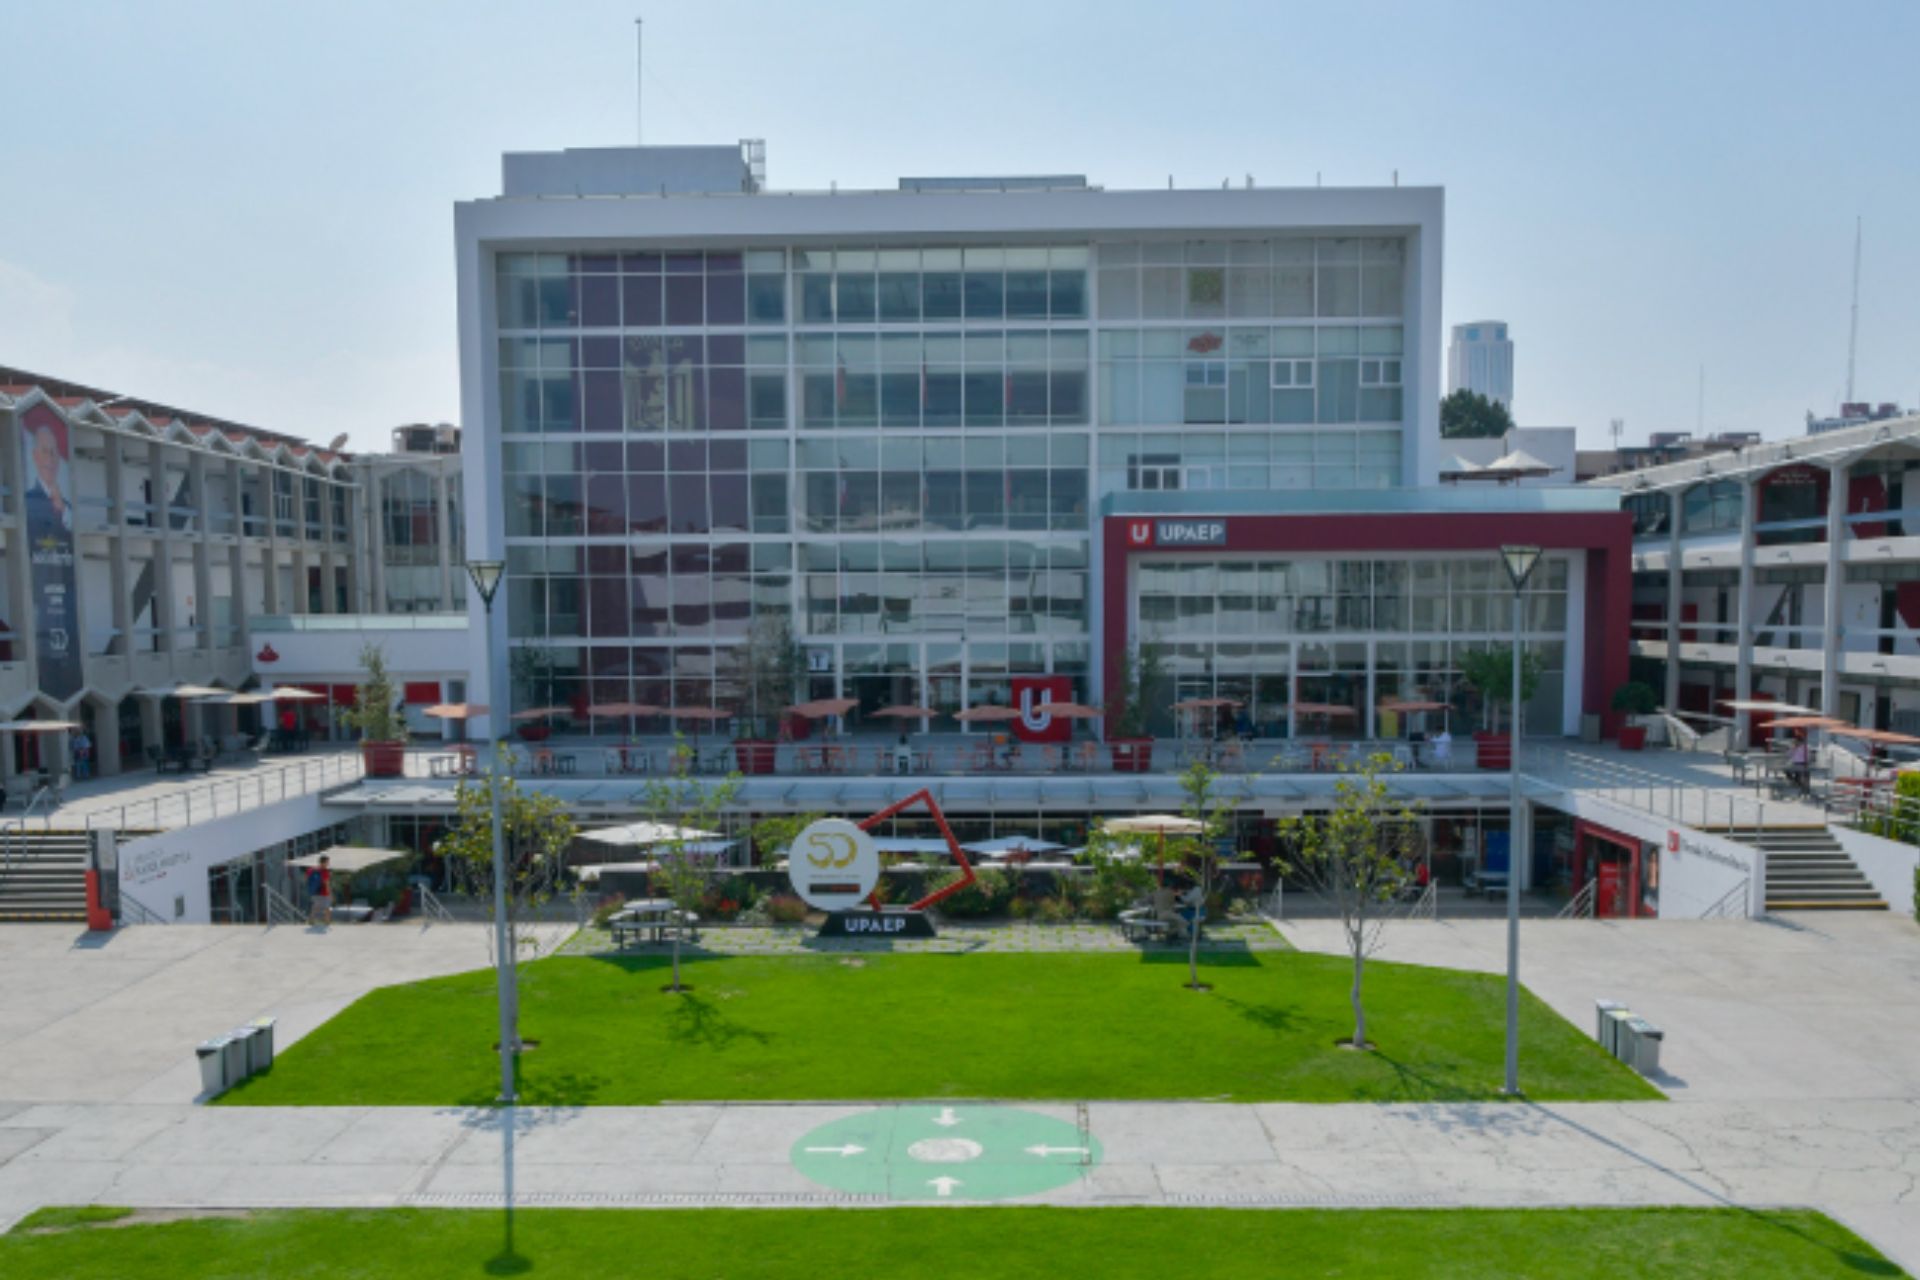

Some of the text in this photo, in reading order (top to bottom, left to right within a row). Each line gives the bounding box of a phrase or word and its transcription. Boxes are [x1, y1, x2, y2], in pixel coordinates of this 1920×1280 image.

[1132, 523, 1223, 543] U UPAEP
[1020, 687, 1052, 732] U
[845, 918, 906, 932] UPAEP
